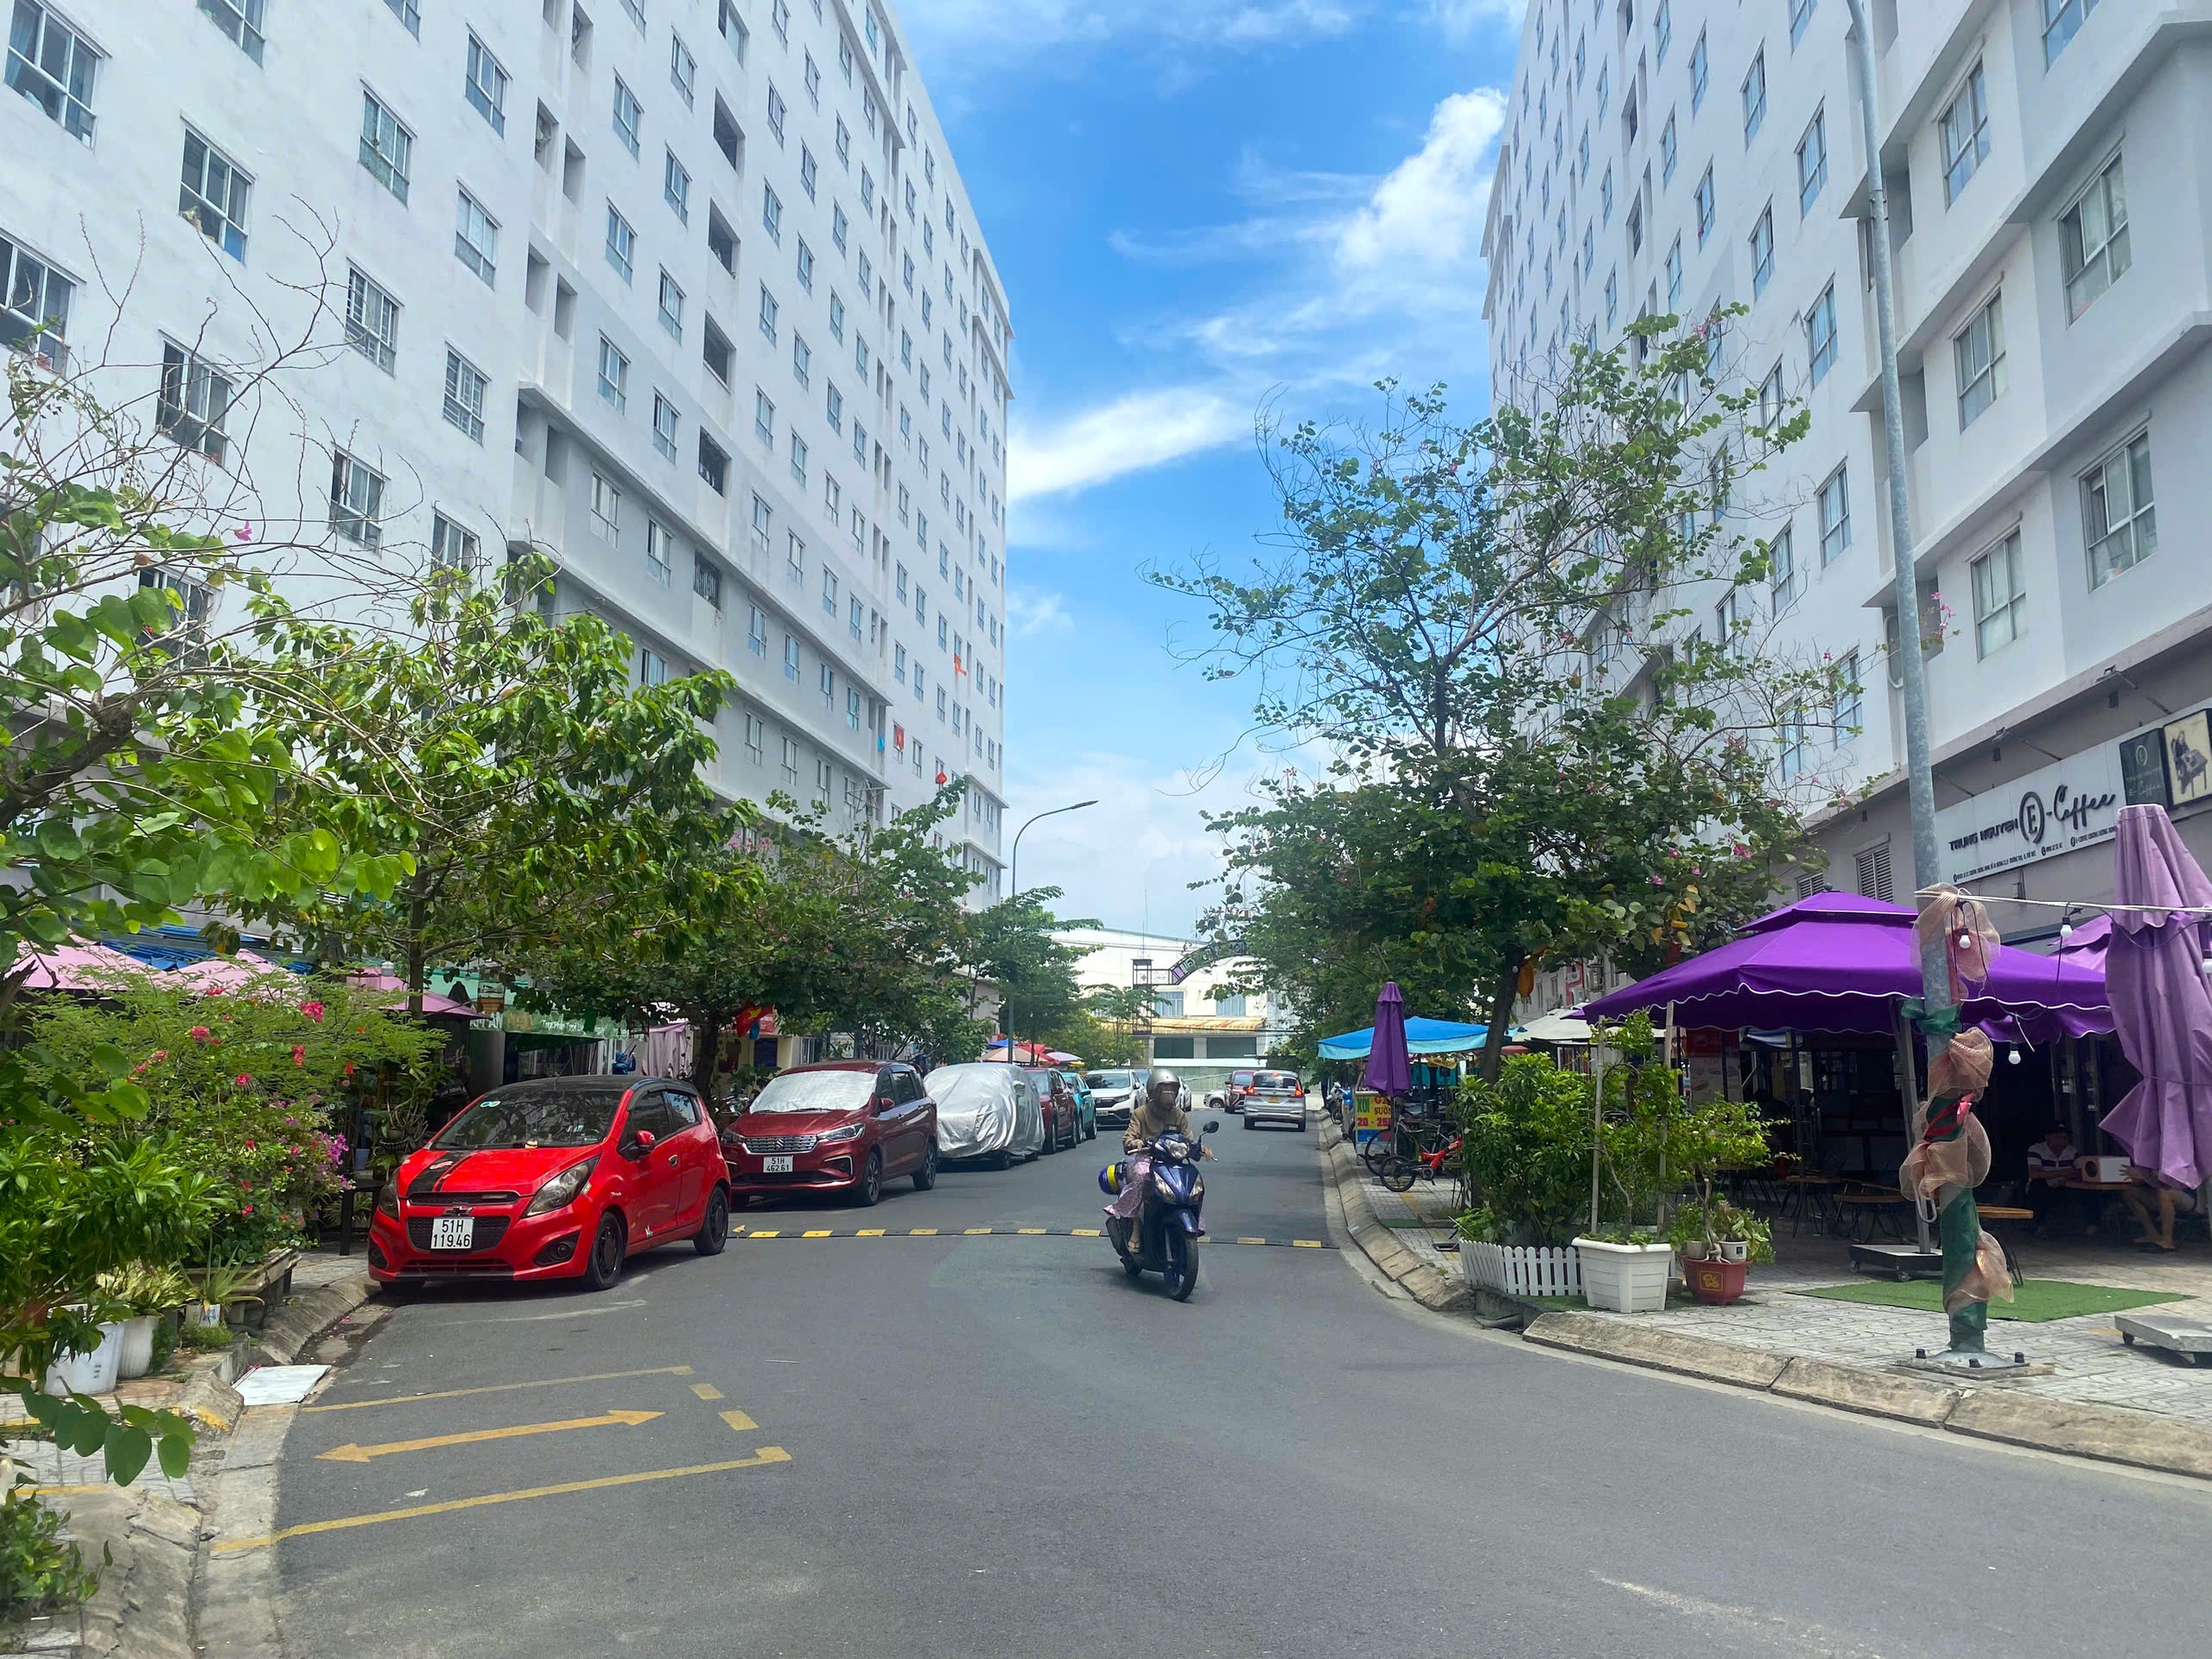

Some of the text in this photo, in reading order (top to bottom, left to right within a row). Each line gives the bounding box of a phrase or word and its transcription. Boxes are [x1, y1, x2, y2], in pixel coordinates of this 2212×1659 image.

[1357, 1117, 1369, 1127] 20
[442, 1219, 464, 1233] 51H
[433, 1234, 471, 1248] 119.46
